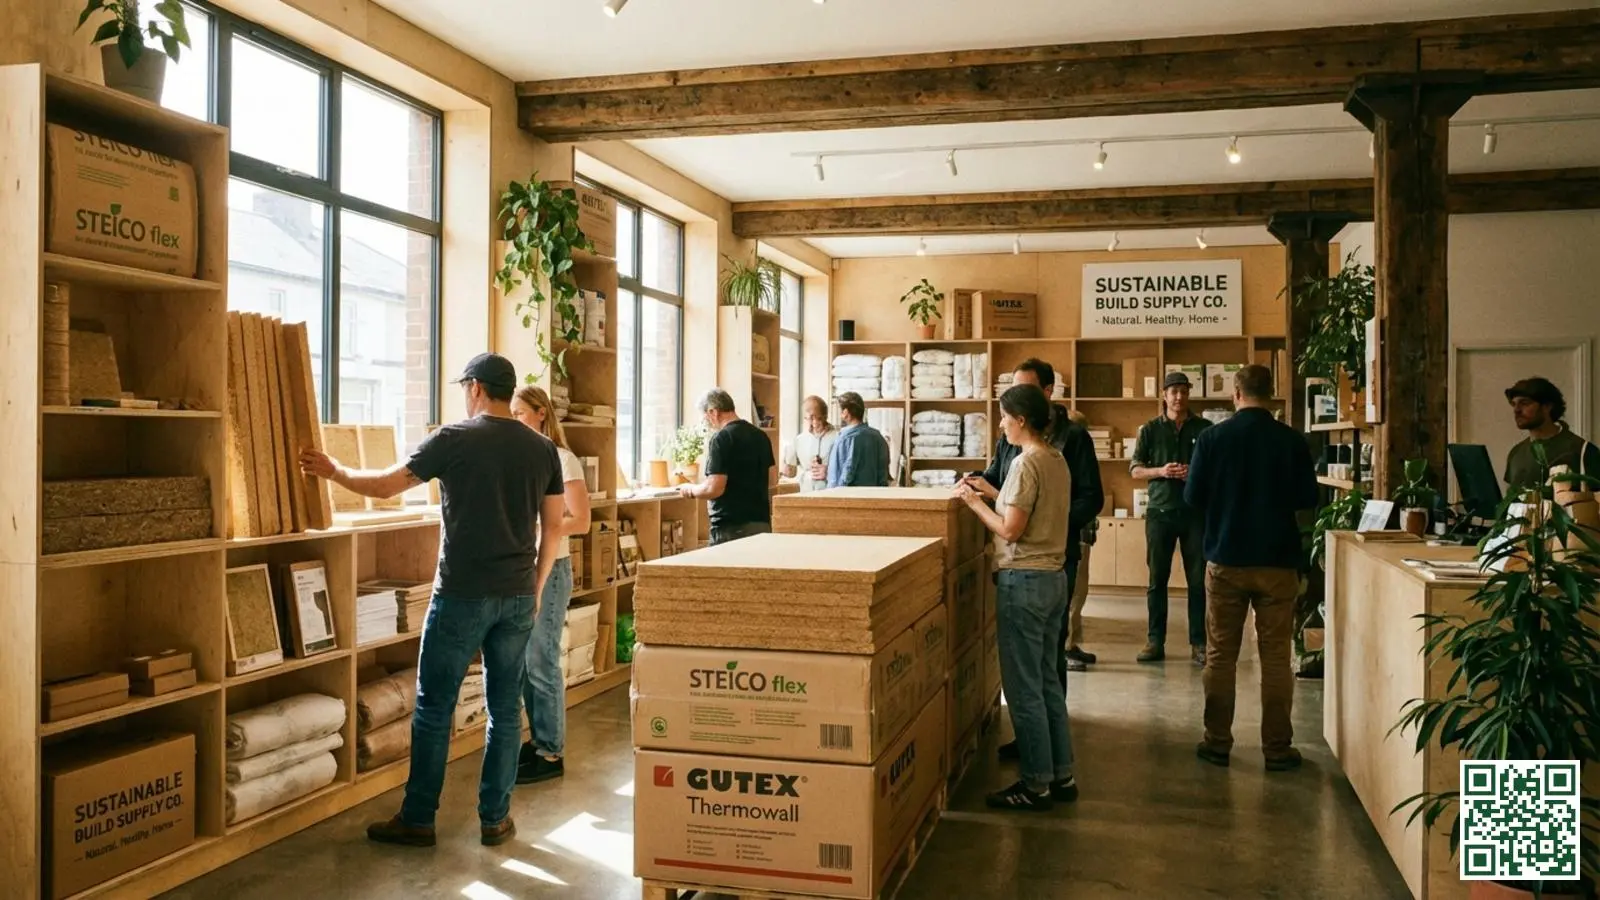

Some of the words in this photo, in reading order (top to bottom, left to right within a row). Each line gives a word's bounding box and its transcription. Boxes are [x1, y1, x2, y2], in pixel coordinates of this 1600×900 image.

[76, 208, 146, 242] STEICO
[150, 224, 180, 248] flex
[1095, 274, 1228, 293] SUSTAINABLE
[1095, 297, 1139, 310] BUILD
[1143, 295, 1199, 309] SUPPLY
[1203, 295, 1228, 308] CO.
[1102, 315, 1142, 325] Natural.
[1145, 315, 1185, 326] Healthy.
[1189, 314, 1219, 324] Home
[690, 668, 767, 692] STEICO
[772, 675, 808, 694] flex
[74, 771, 183, 824] SUSTAINABLE
[686, 795, 799, 822] Thermowall
[75, 817, 114, 844] BUILD
[117, 798, 164, 828] SUPPLY
[165, 793, 185, 811] CO.
